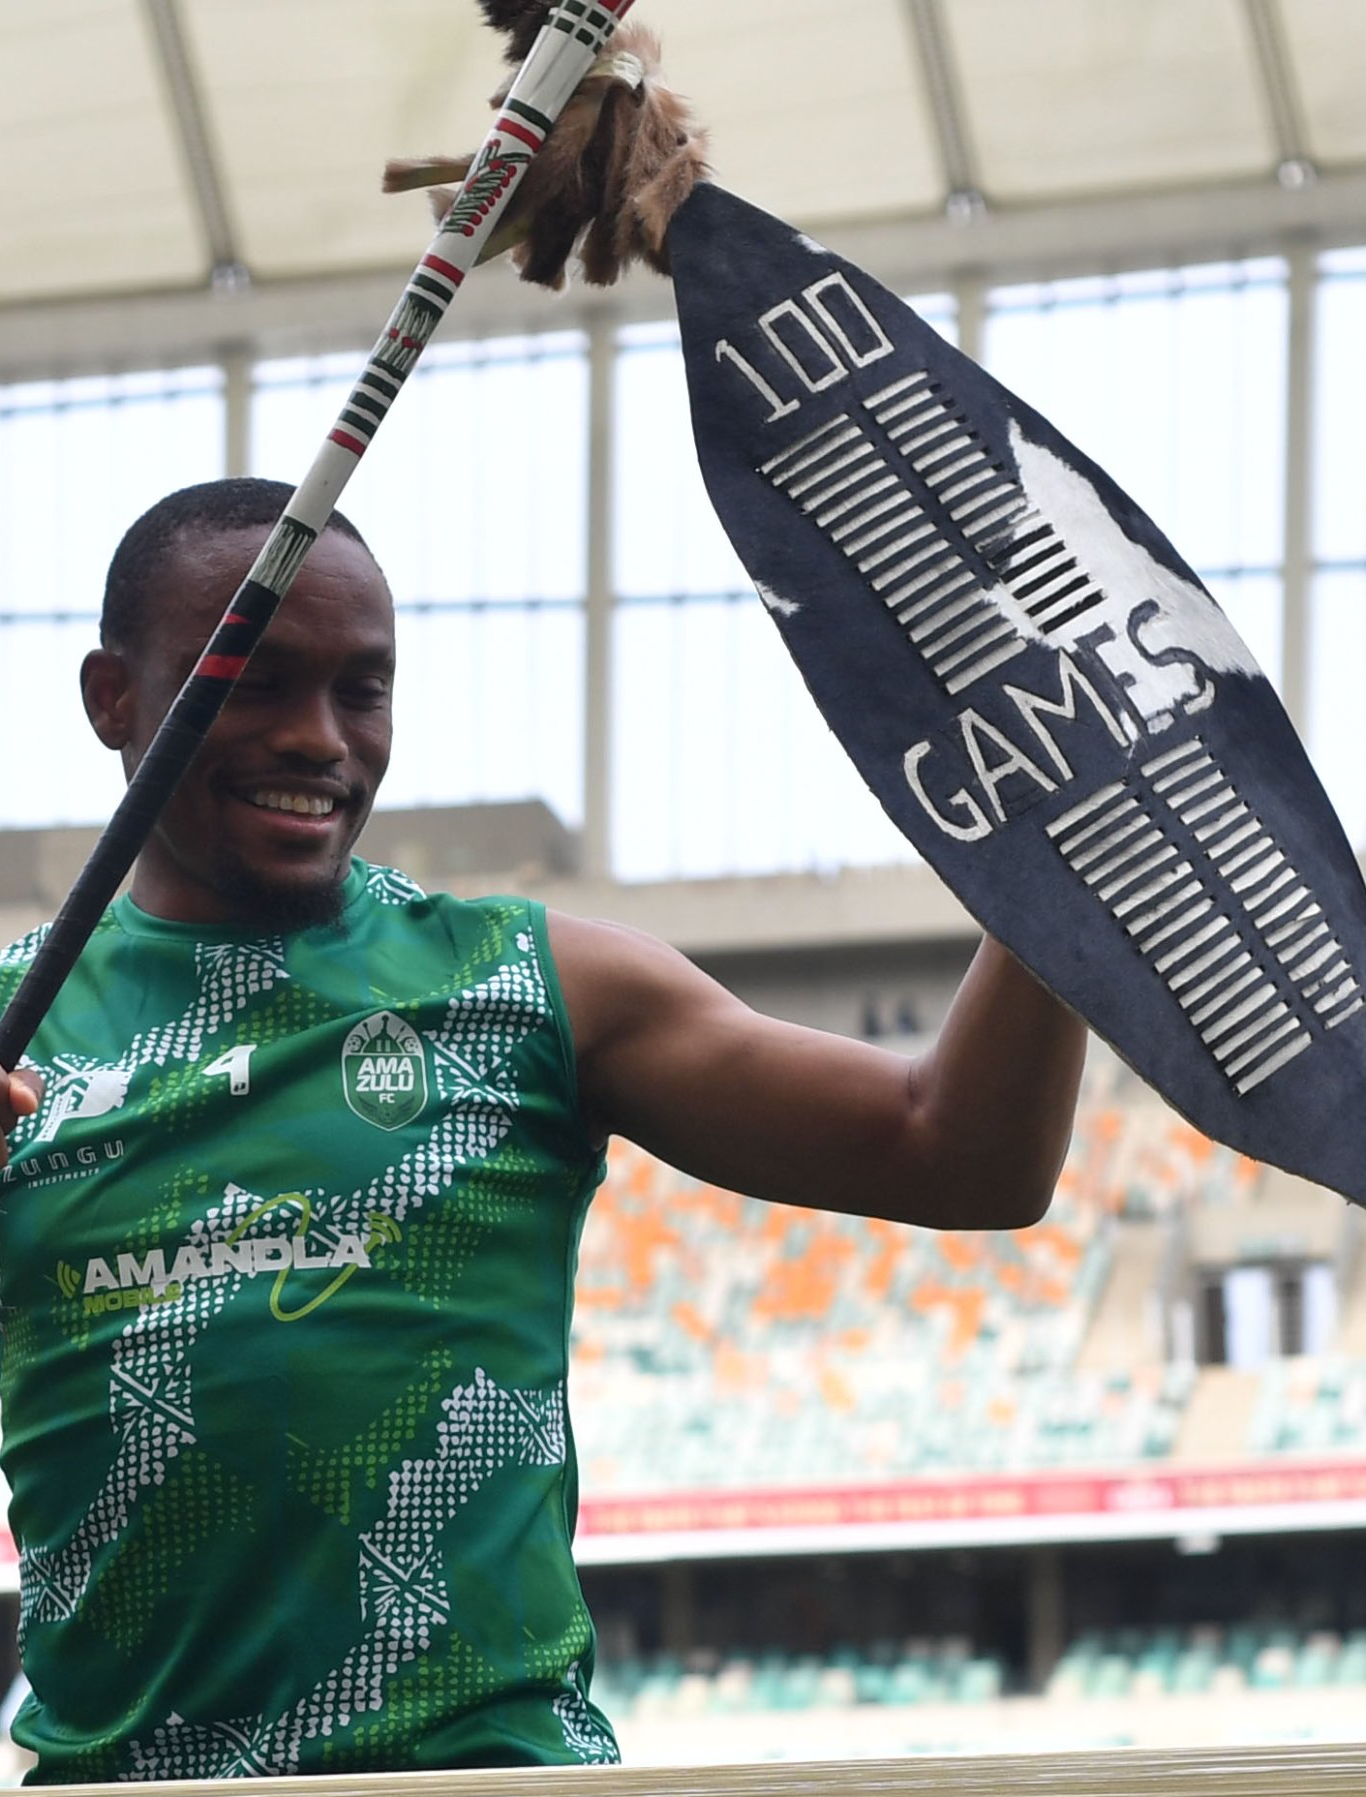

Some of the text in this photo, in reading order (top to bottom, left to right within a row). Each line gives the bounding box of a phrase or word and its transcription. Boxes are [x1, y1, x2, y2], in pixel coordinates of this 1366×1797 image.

[714, 271, 897, 424] 100
[901, 599, 1220, 845] GAMES
[358, 1057, 414, 1074] AMA
[355, 1075, 414, 1092] ZULU
[379, 1093, 395, 1103] FC
[28, 1167, 100, 1190] INVESTMENTS
[83, 1234, 373, 1294] AMANDLA
[85, 1283, 183, 1315] MOBILE
